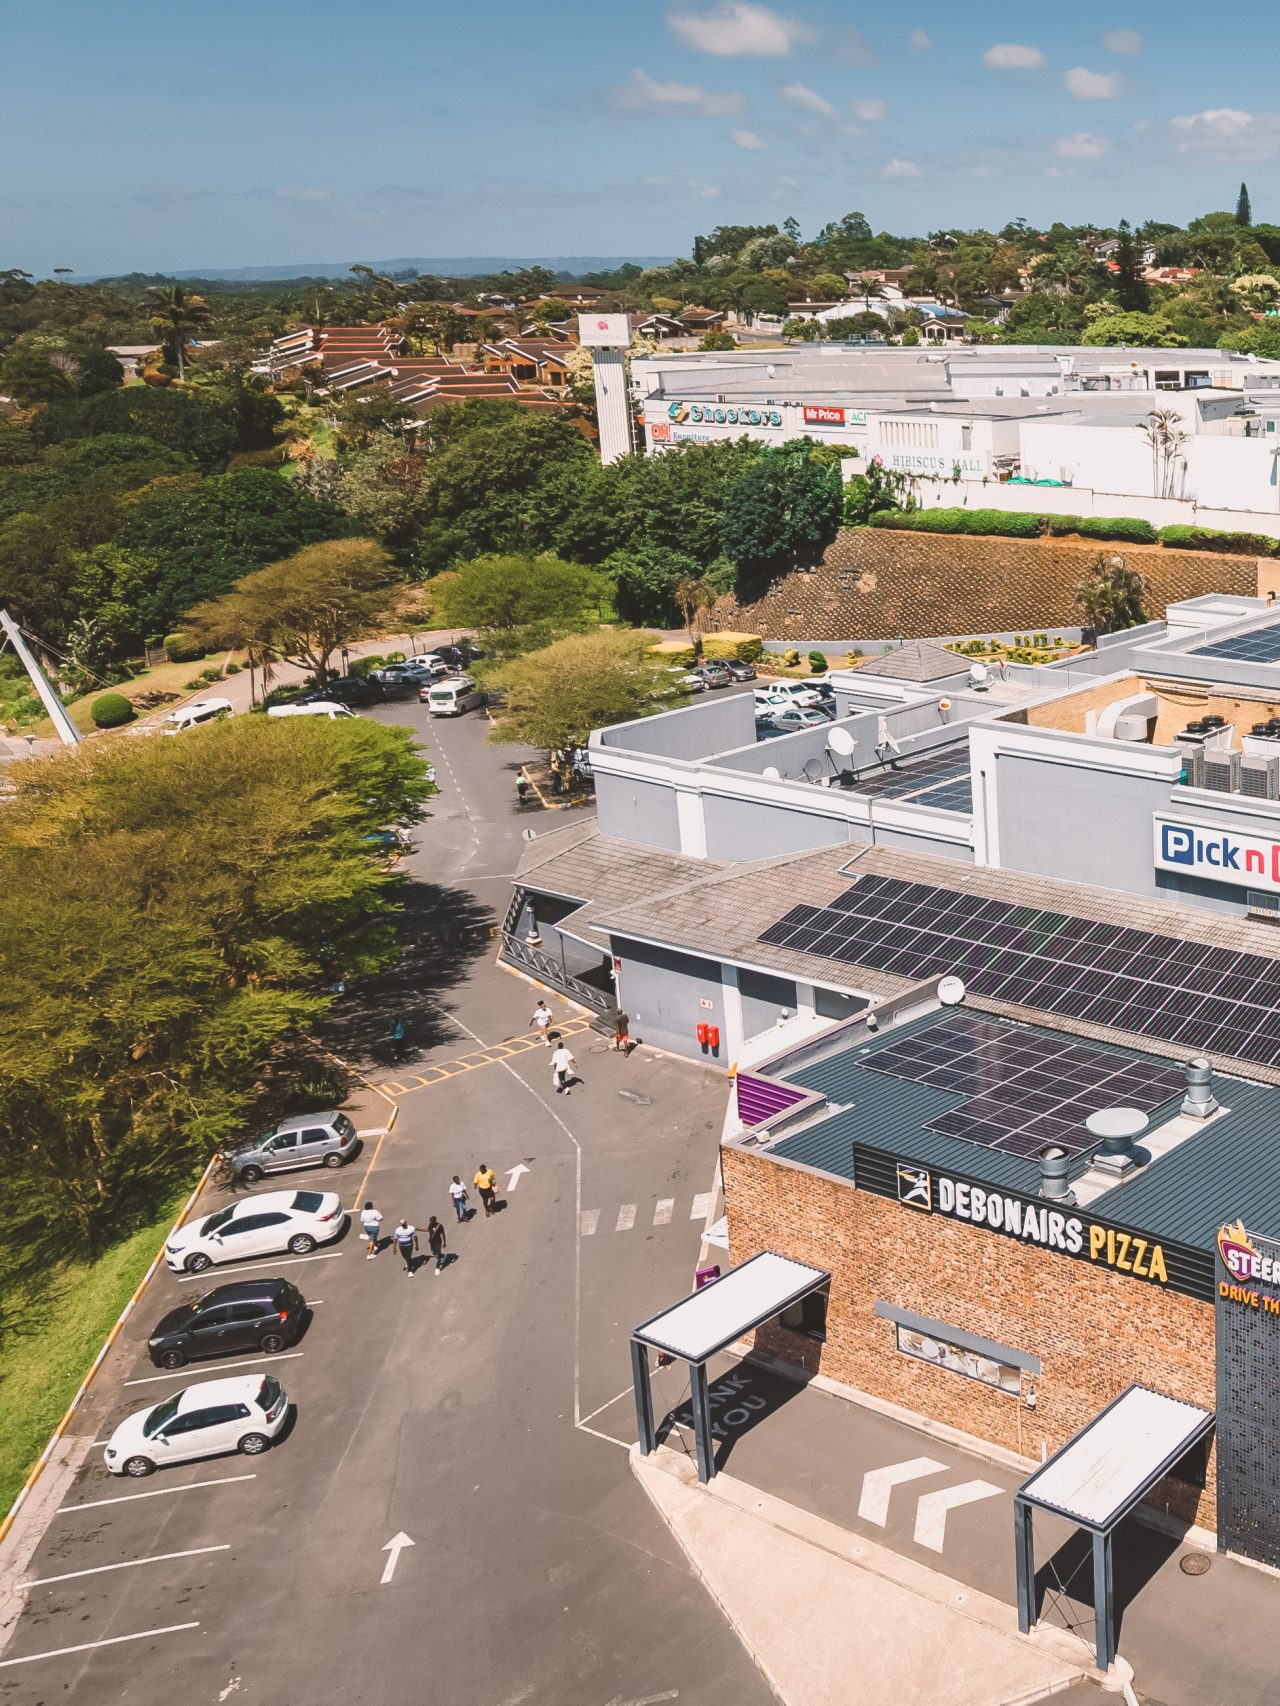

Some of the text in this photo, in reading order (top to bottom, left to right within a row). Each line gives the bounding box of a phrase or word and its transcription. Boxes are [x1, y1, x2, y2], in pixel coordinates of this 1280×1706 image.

[691, 405, 782, 426] Checkers
[806, 408, 841, 421] Mr Price
[651, 422, 671, 441] OK
[672, 431, 710, 442] Furniture
[892, 454, 983, 472] HIBISCUS MALL
[1162, 824, 1240, 870] Pick
[1245, 849, 1265, 874] n
[938, 1176, 1169, 1283] DEBONAIRS PIZZA
[1219, 1281, 1260, 1307] DRIVE
[711, 1394, 767, 1437] YOU
